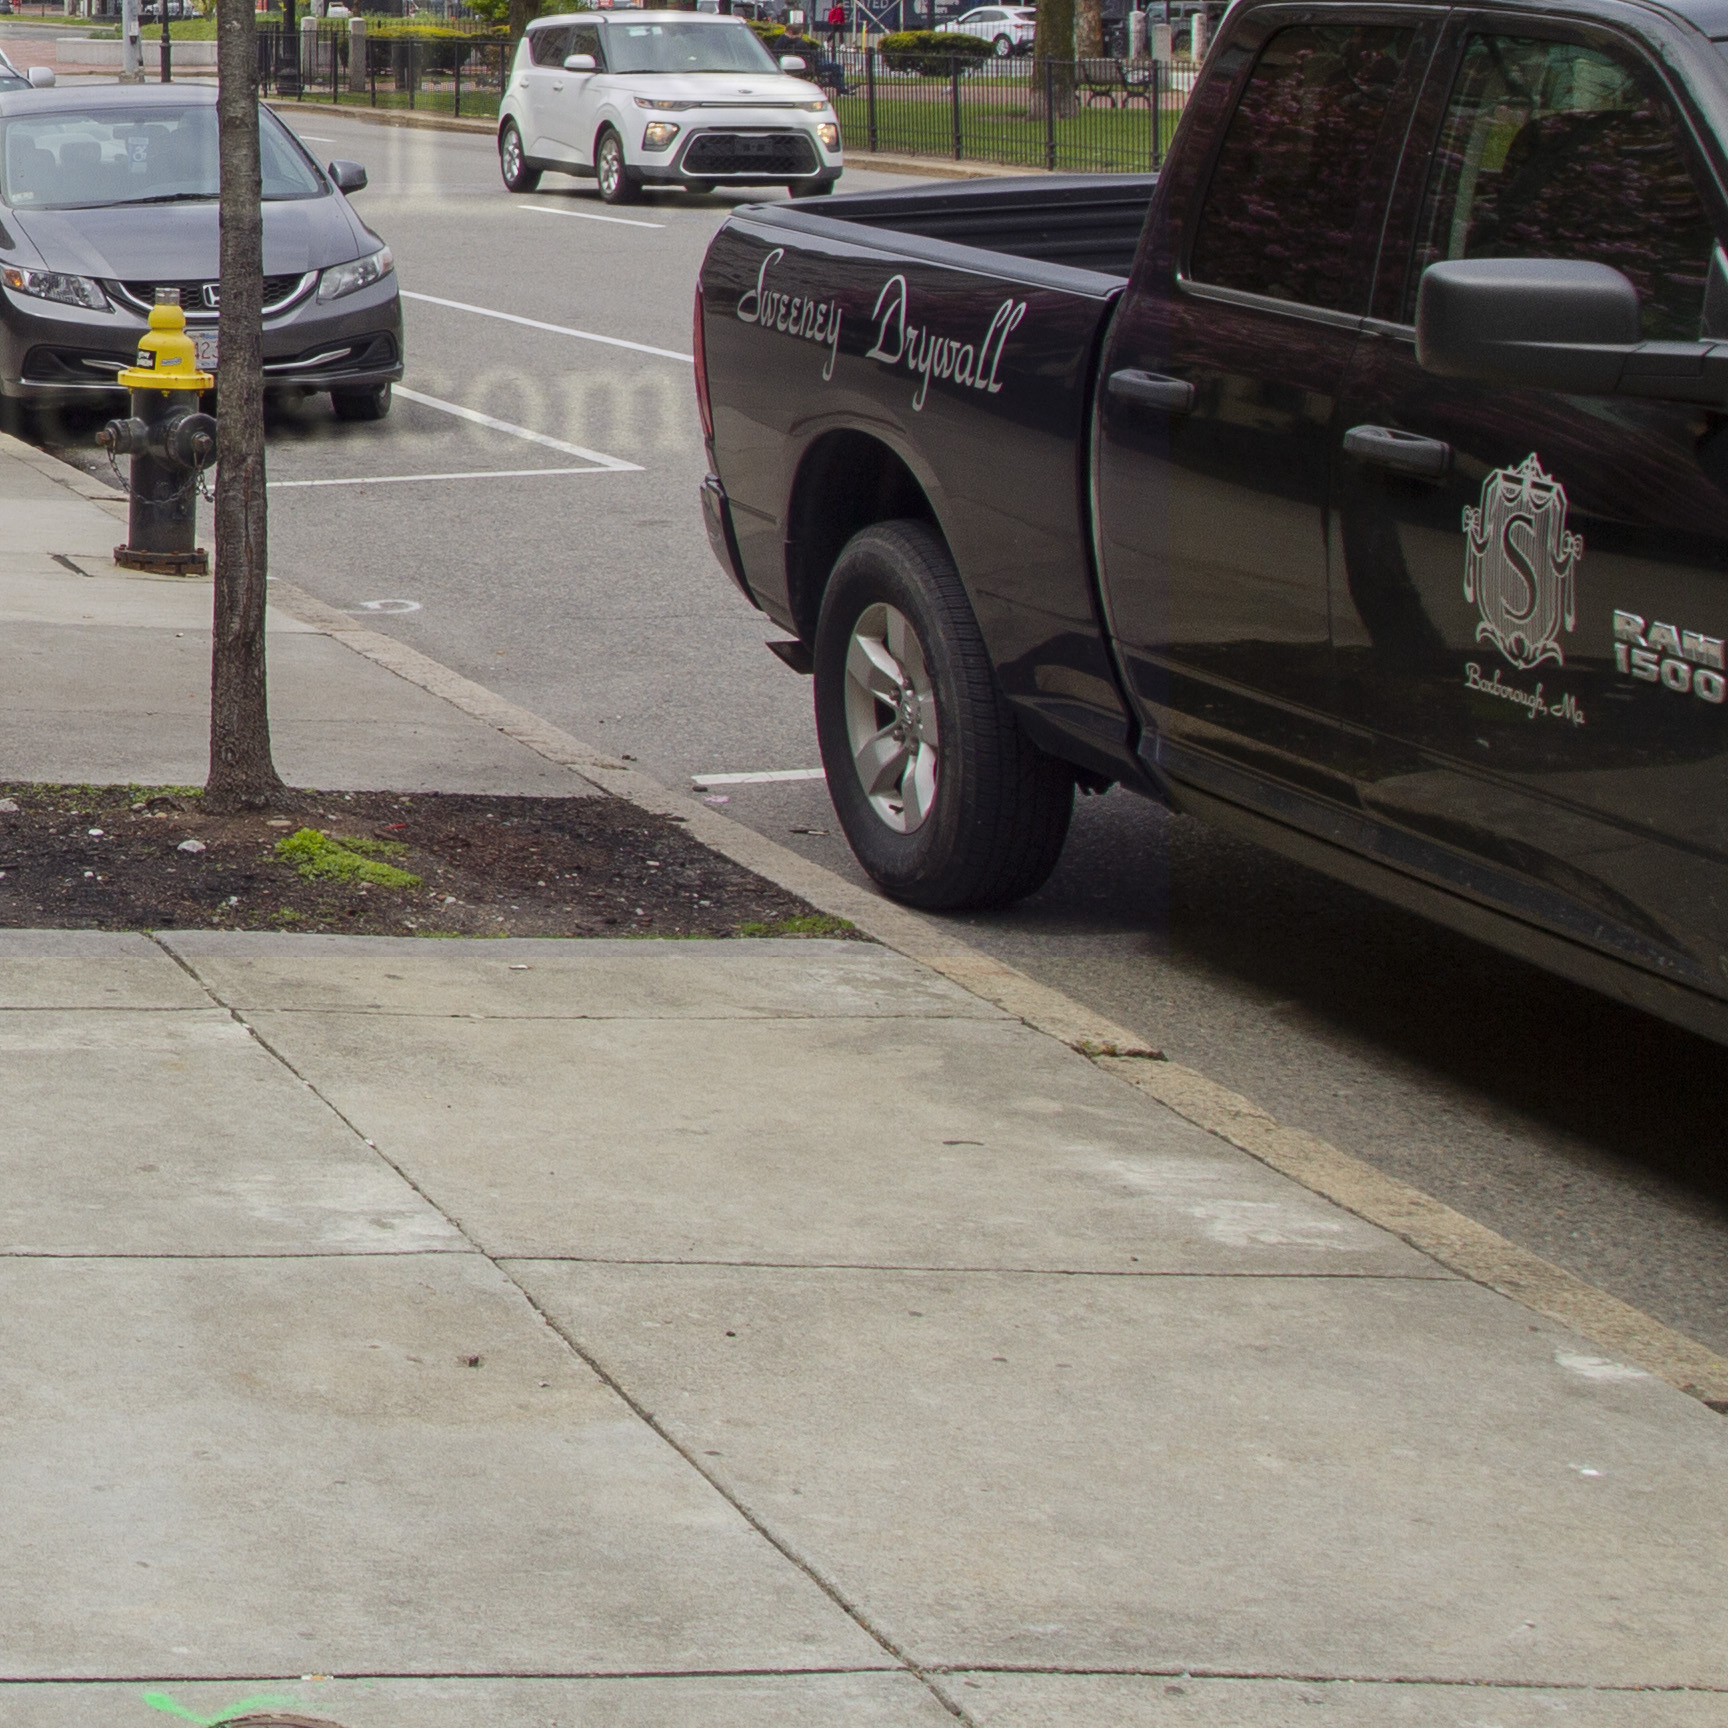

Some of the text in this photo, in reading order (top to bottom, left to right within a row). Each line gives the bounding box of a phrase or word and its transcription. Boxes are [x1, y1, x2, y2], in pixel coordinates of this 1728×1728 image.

[736, 248, 1027, 412] Sweeney Drywall
[1500, 511, 1539, 625] S
[1613, 609, 1726, 671] RAM
[1613, 641, 1727, 704] 1500
[1550, 692, 1586, 725] Ma
